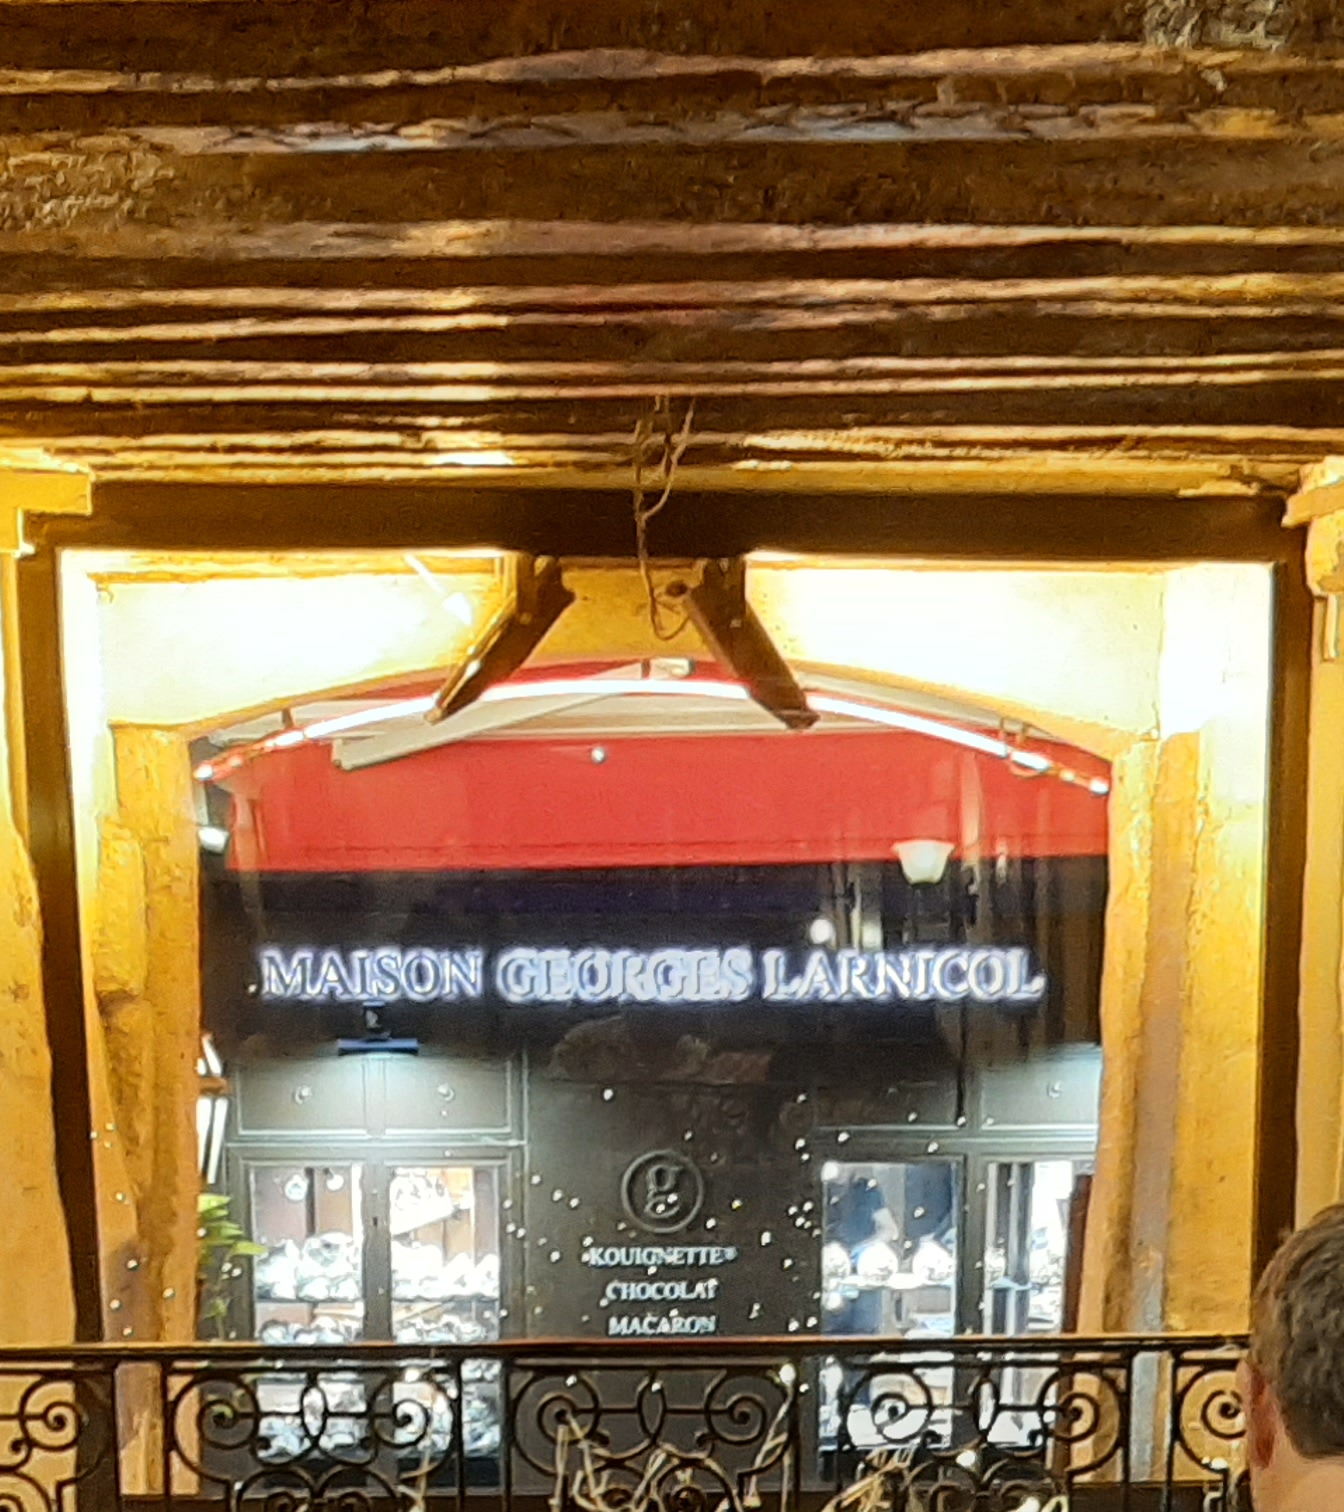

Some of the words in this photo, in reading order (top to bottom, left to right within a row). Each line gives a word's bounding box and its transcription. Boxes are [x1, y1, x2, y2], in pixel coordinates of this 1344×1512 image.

[260, 947, 484, 999] MAISON
[496, 946, 753, 1001] GEORGES
[761, 946, 1047, 1001] LARNICOL
[606, 1280, 718, 1300] CHOCOLAT
[609, 1315, 716, 1336] MACARON
